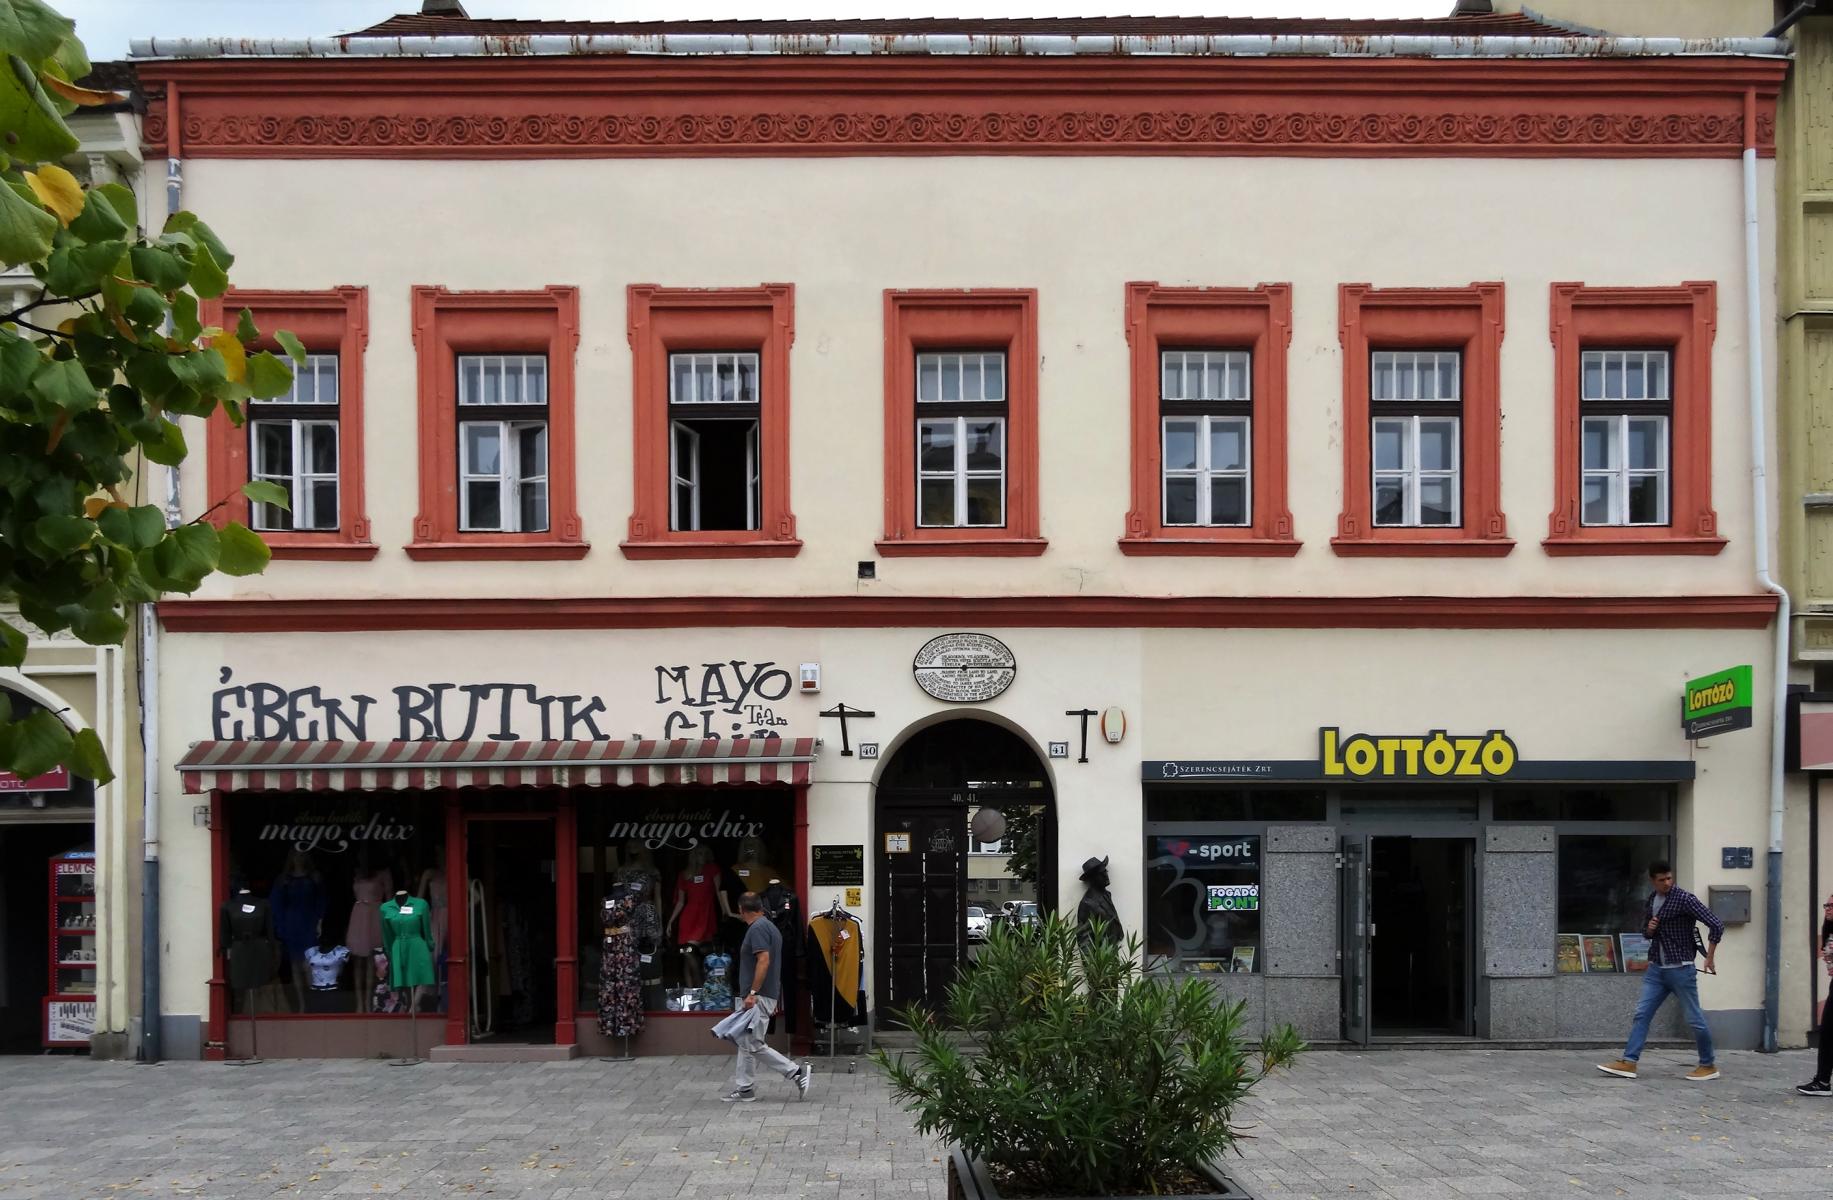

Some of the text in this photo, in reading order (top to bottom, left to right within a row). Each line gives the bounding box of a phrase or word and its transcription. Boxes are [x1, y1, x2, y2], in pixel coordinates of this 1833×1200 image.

[212, 666, 611, 741] ÉBEN BUTIK
[655, 660, 792, 714] MAYO
[862, 746, 876, 756] 40
[1052, 746, 1065, 755] 41
[1324, 730, 1515, 776] LOTTÓZÓ
[258, 811, 416, 854] mayo chix
[609, 808, 765, 851] mayo chix
[1211, 884, 1258, 897] FOGADÓ
[1211, 897, 1258, 910] PONT
